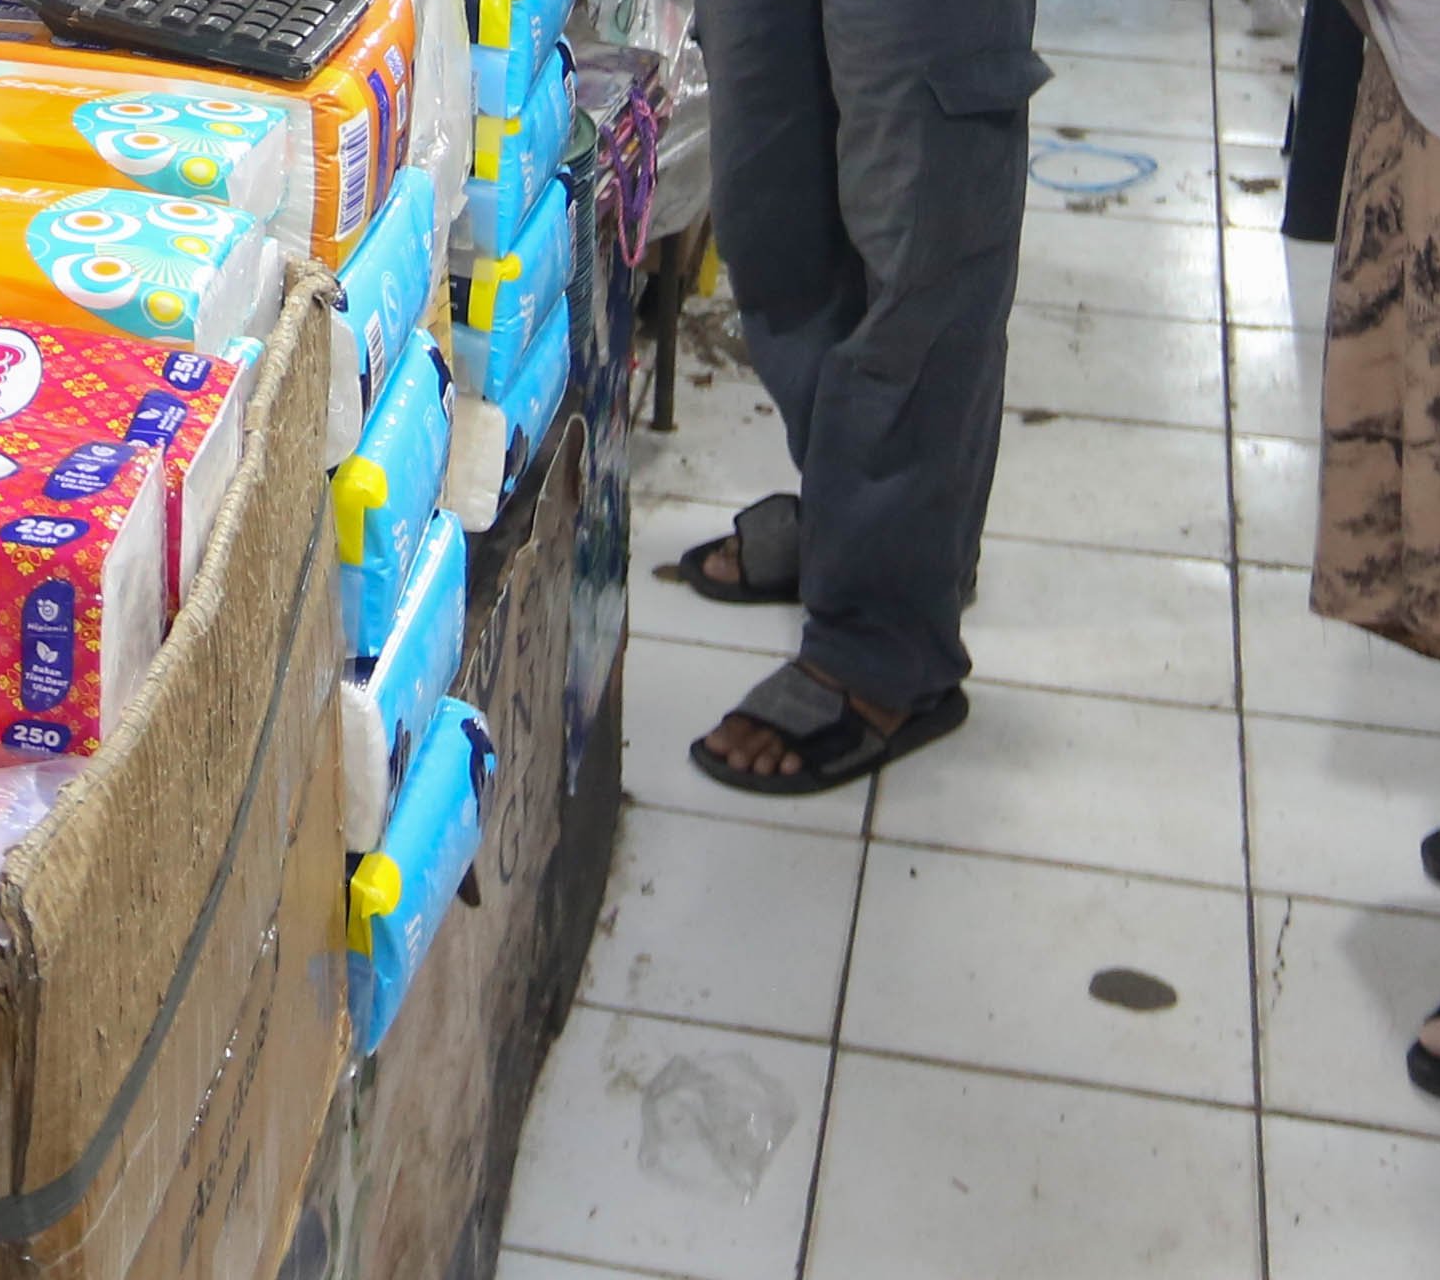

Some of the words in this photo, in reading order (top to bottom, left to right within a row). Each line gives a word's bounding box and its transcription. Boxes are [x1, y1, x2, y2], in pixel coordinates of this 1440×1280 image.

[168, 352, 199, 384] 250
[14, 517, 76, 540] 250
[12, 724, 61, 747] 250
